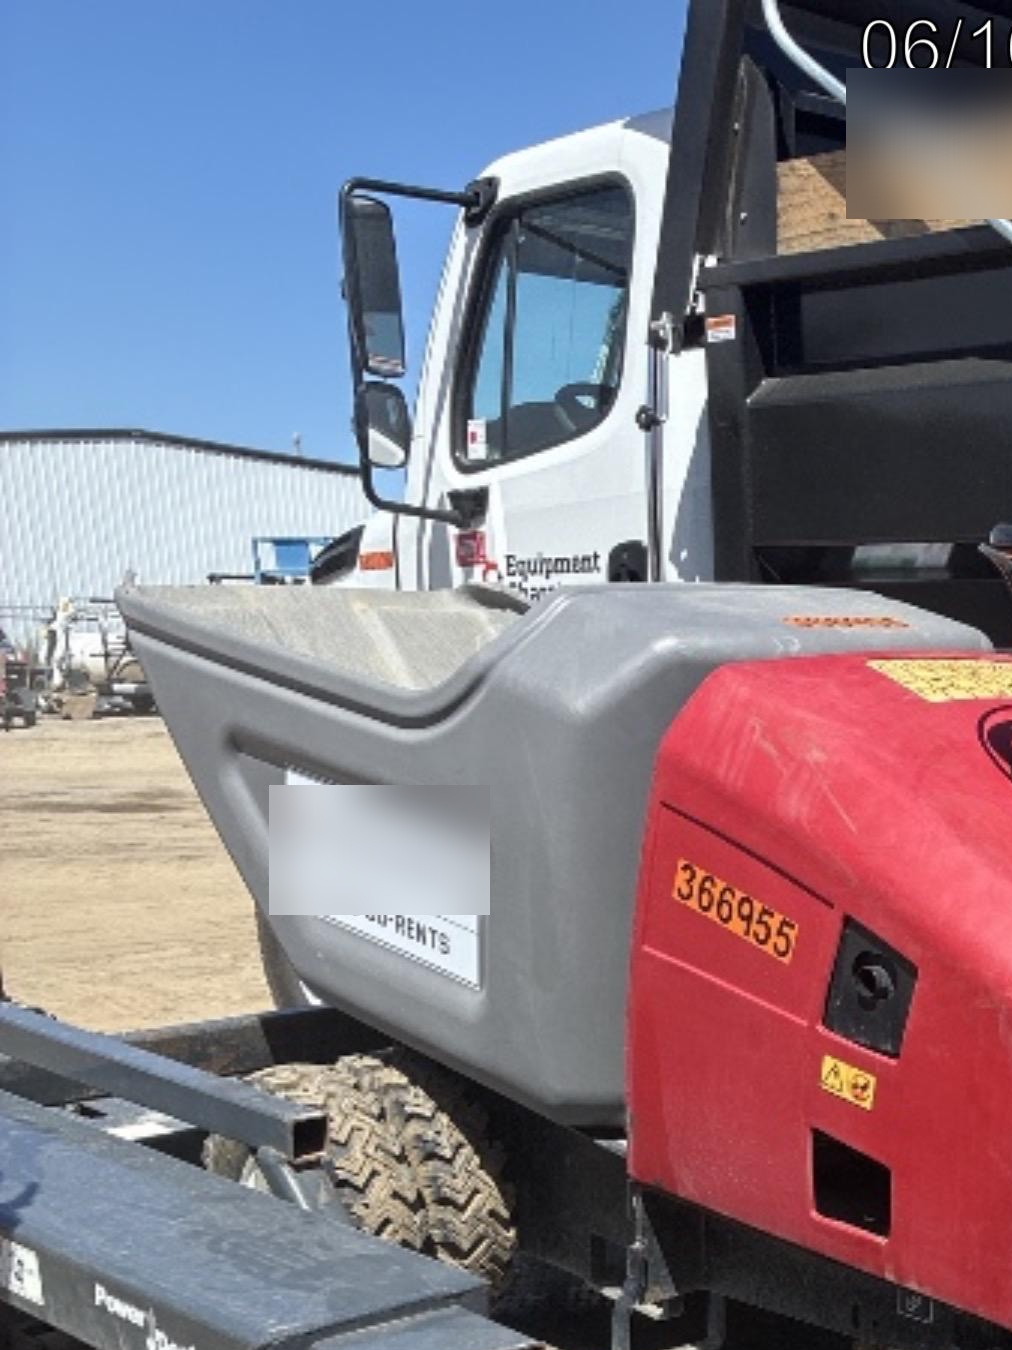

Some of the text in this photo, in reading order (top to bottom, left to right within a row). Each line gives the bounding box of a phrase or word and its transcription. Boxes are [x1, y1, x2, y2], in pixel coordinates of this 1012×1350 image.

[504, 552, 601, 581] Equipment
[676, 862, 796, 959] 366955
[94, 1283, 146, 1328] Power
